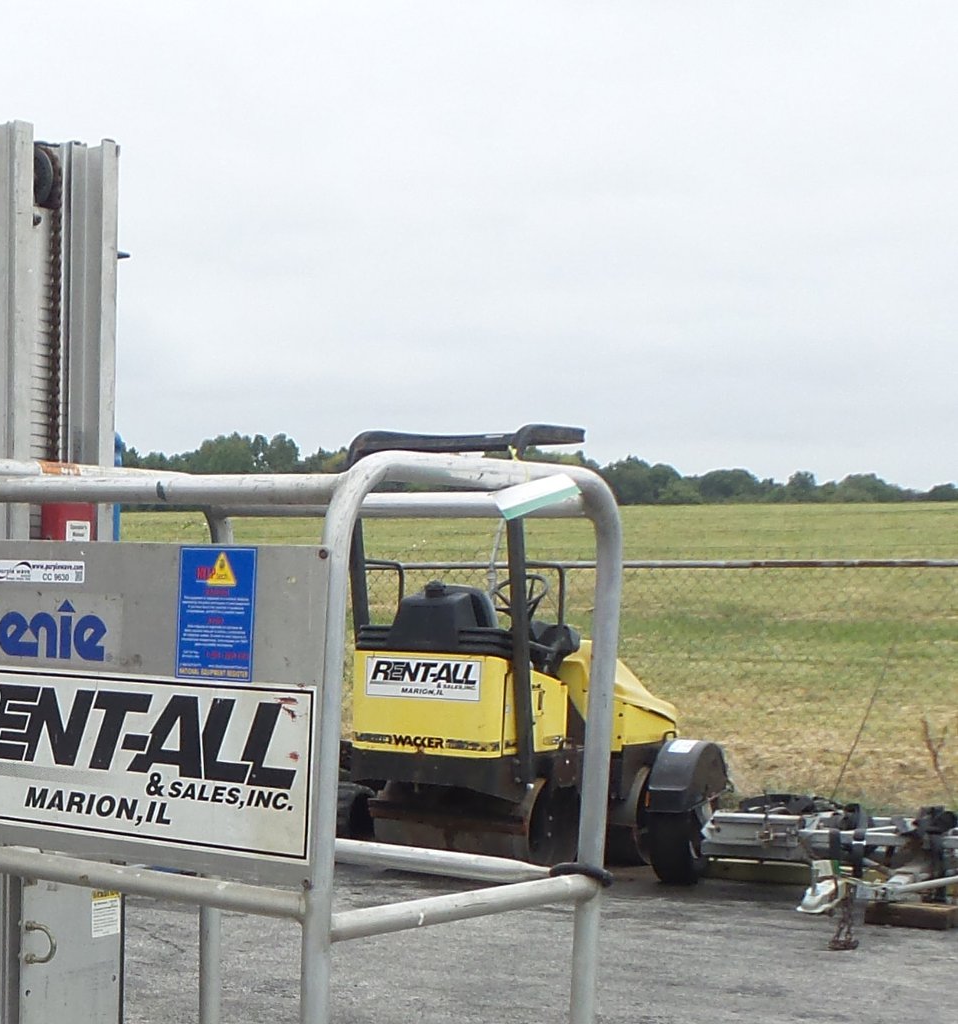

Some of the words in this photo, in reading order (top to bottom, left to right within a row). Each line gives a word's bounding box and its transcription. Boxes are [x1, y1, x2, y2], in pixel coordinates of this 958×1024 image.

[54, 573, 70, 581] 9630
[371, 660, 477, 685] RENT-ALL
[393, 734, 444, 748] WACKER
[145, 772, 165, 797] &
